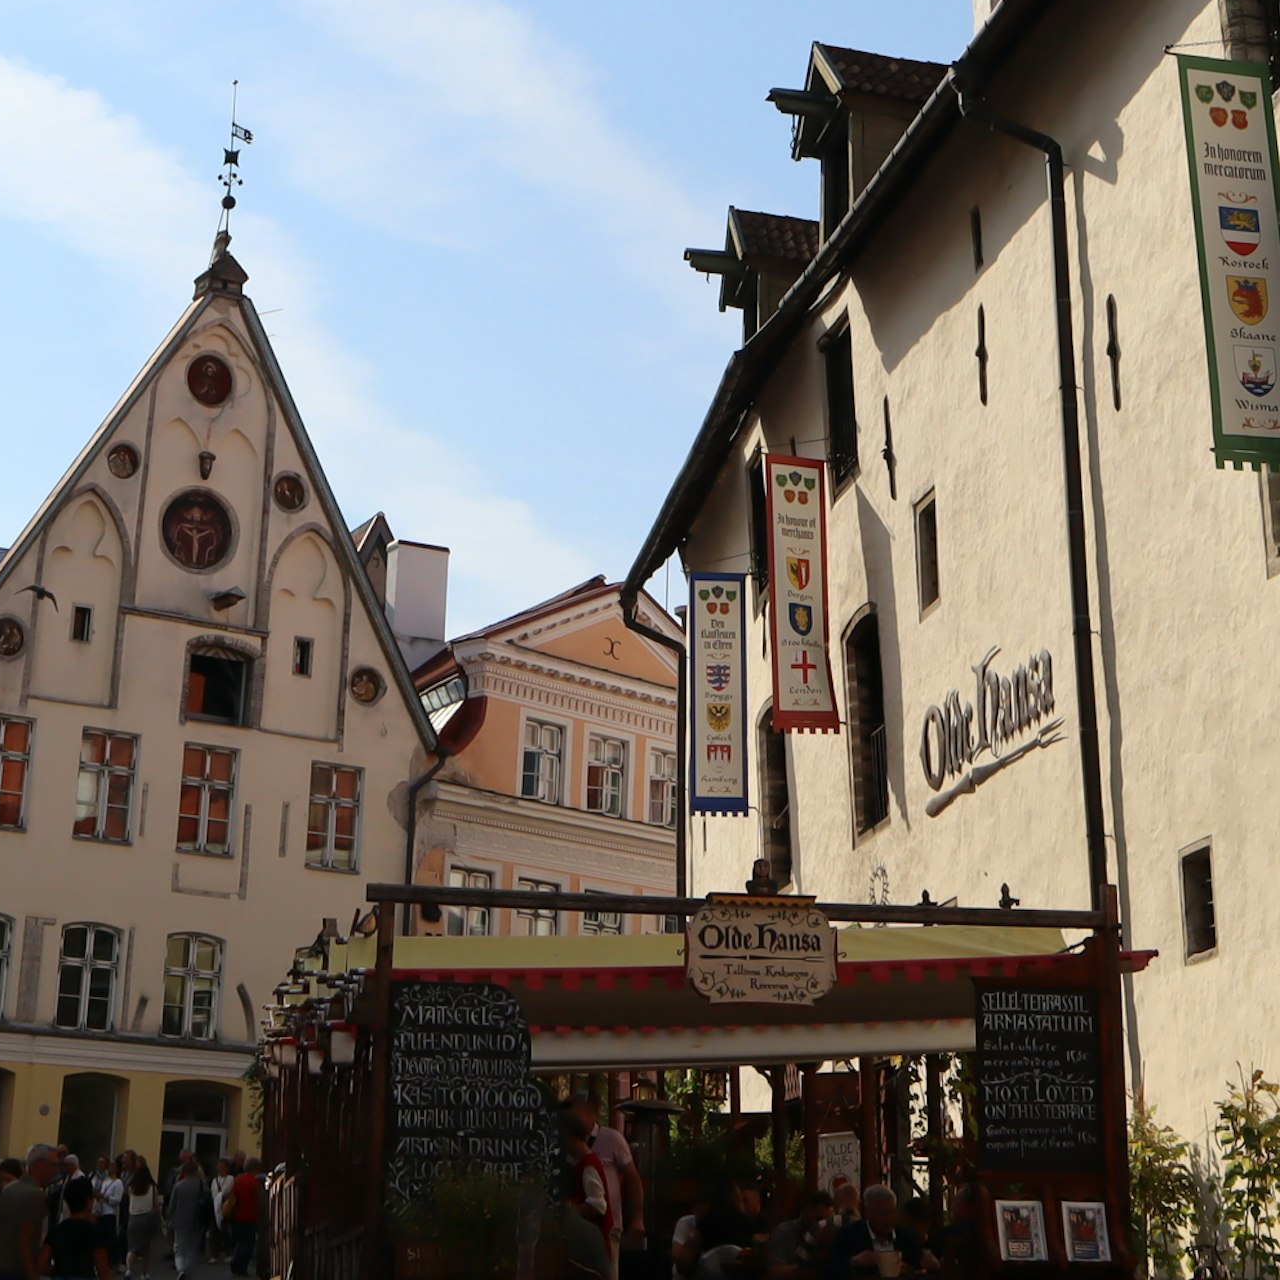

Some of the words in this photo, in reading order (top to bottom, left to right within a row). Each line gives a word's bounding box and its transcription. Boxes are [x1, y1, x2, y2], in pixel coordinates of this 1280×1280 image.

[1217, 144, 1262, 164] honorem
[1204, 162, 1266, 181] mercatorum
[1219, 256, 1270, 270] Rostock
[1230, 327, 1277, 342] Skaane
[789, 685, 822, 695] London
[698, 924, 752, 950] Olde
[984, 1084, 1030, 1101] MOST
[1033, 1079, 1094, 1103] LOVED
[396, 1106, 455, 1129] KOHALIK
[984, 1104, 1006, 1120] ON
[1007, 1104, 1041, 1120] THIS
[1042, 1104, 1097, 1120] TERRACE
[467, 1137, 541, 1157] DRINKS
[825, 1142, 853, 1156] OLDE
